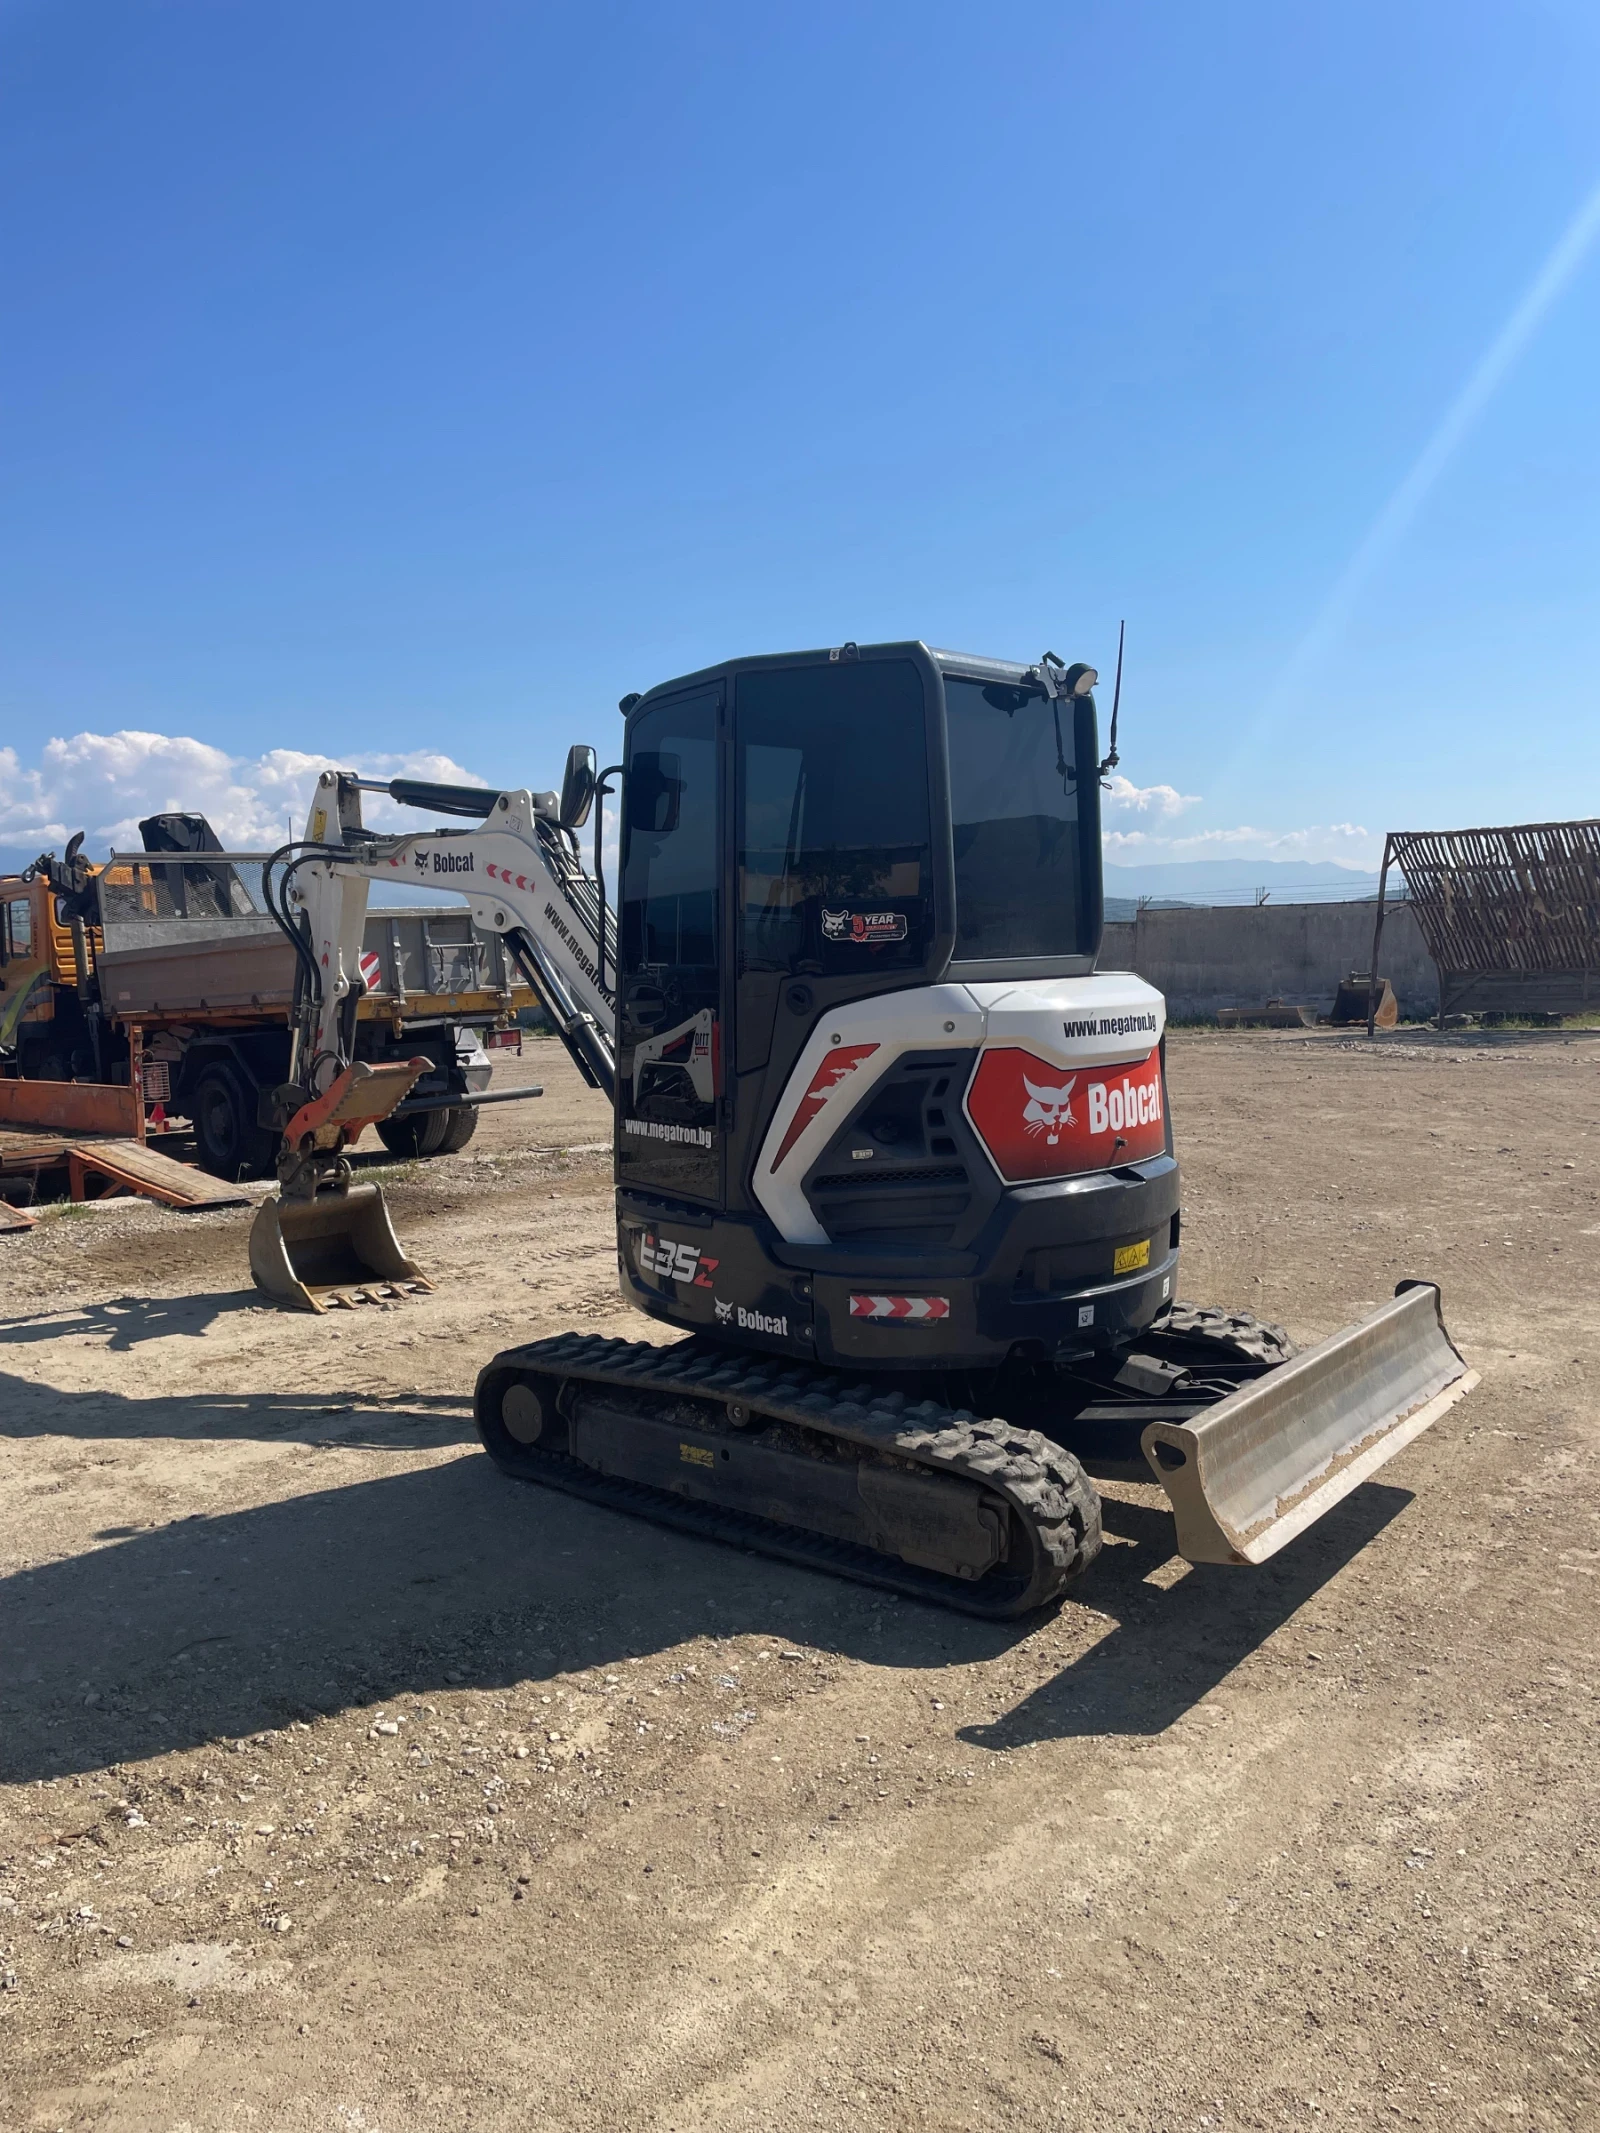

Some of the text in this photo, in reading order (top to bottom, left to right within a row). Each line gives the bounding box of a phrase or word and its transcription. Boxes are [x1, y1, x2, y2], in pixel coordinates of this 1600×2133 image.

[433, 851, 475, 873] Bobcat
[852, 915, 894, 933] 5 YEAR
[1063, 1012, 1157, 1038] www.megatron.bg
[1087, 1074, 1161, 1135] Bobcat
[625, 1119, 712, 1149] www.megatron.bg
[737, 1306, 788, 1336] Bobcat
